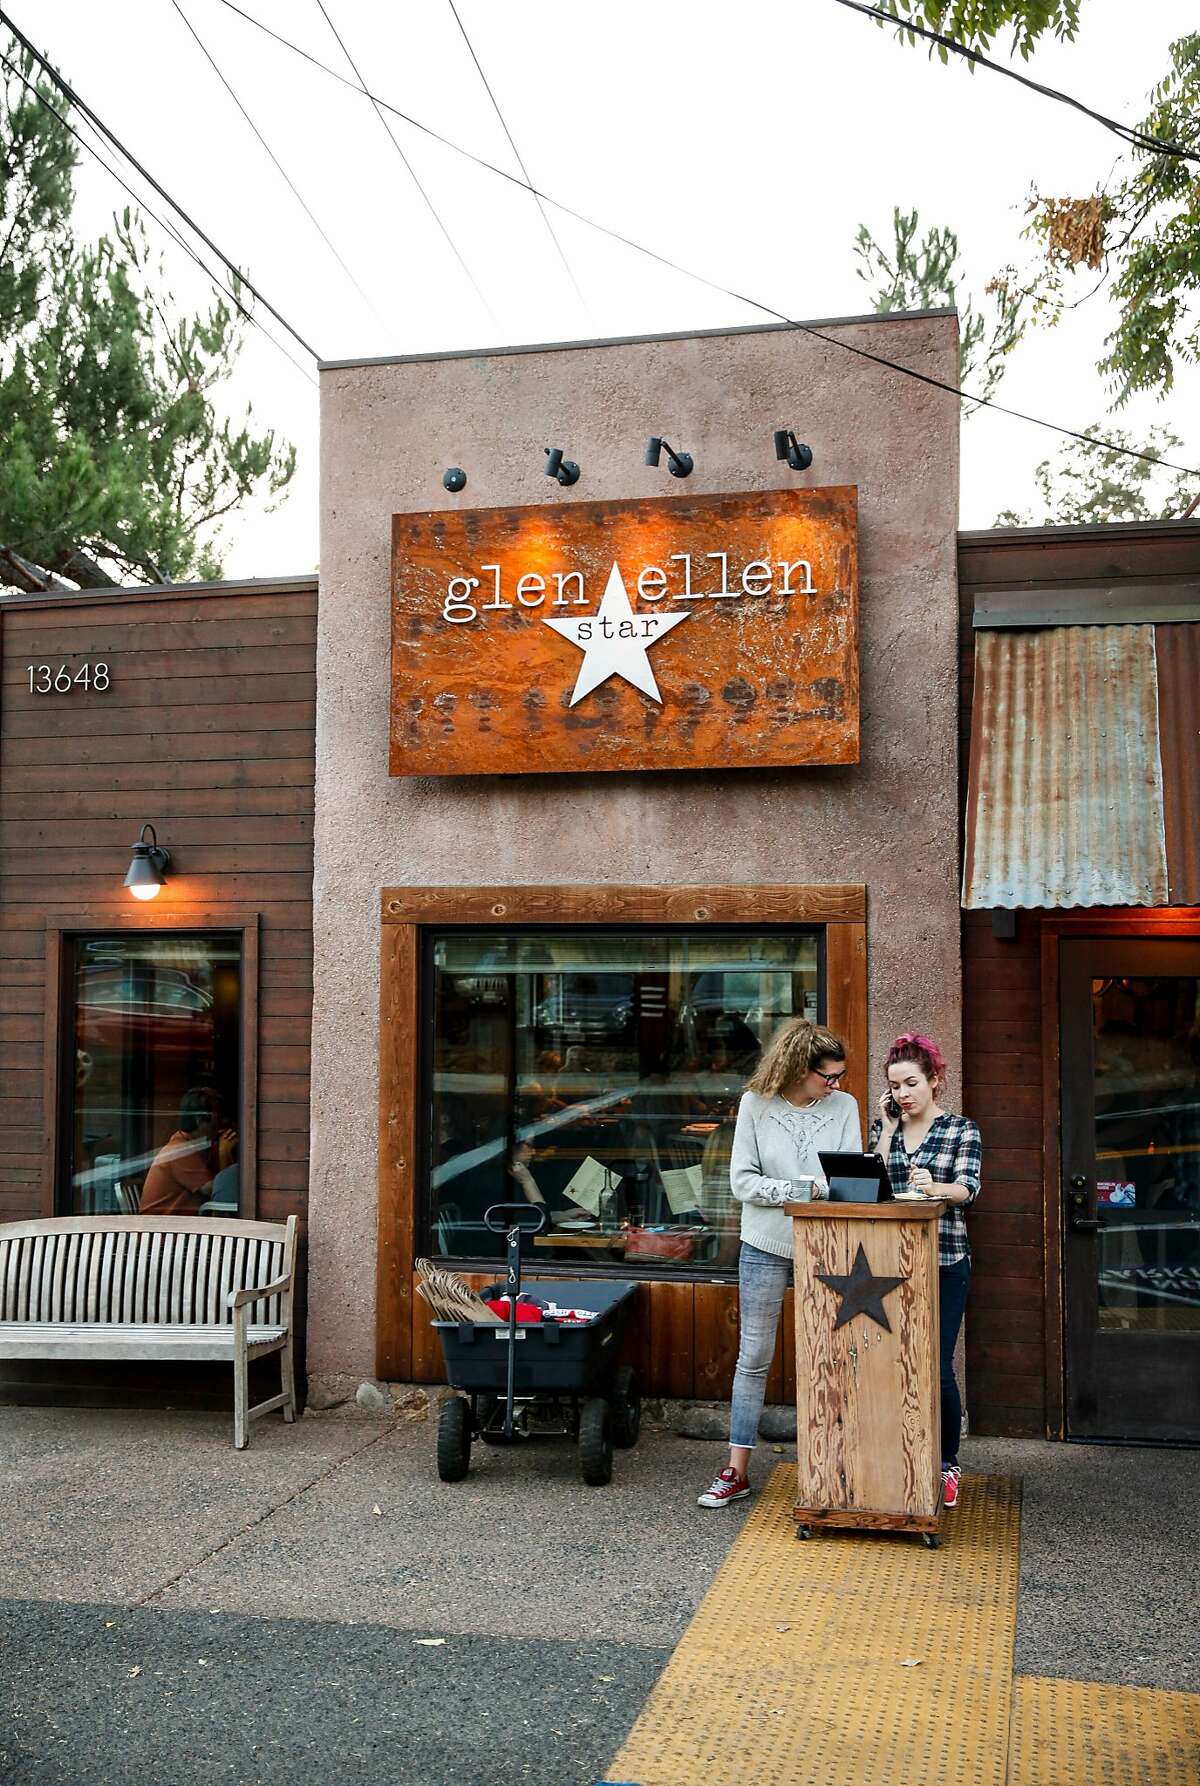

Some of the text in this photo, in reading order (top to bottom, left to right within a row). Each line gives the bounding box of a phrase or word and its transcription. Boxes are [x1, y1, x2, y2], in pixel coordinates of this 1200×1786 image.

[442, 551, 818, 623] glen ellen
[577, 615, 660, 641] star
[26, 662, 110, 693] 13648
